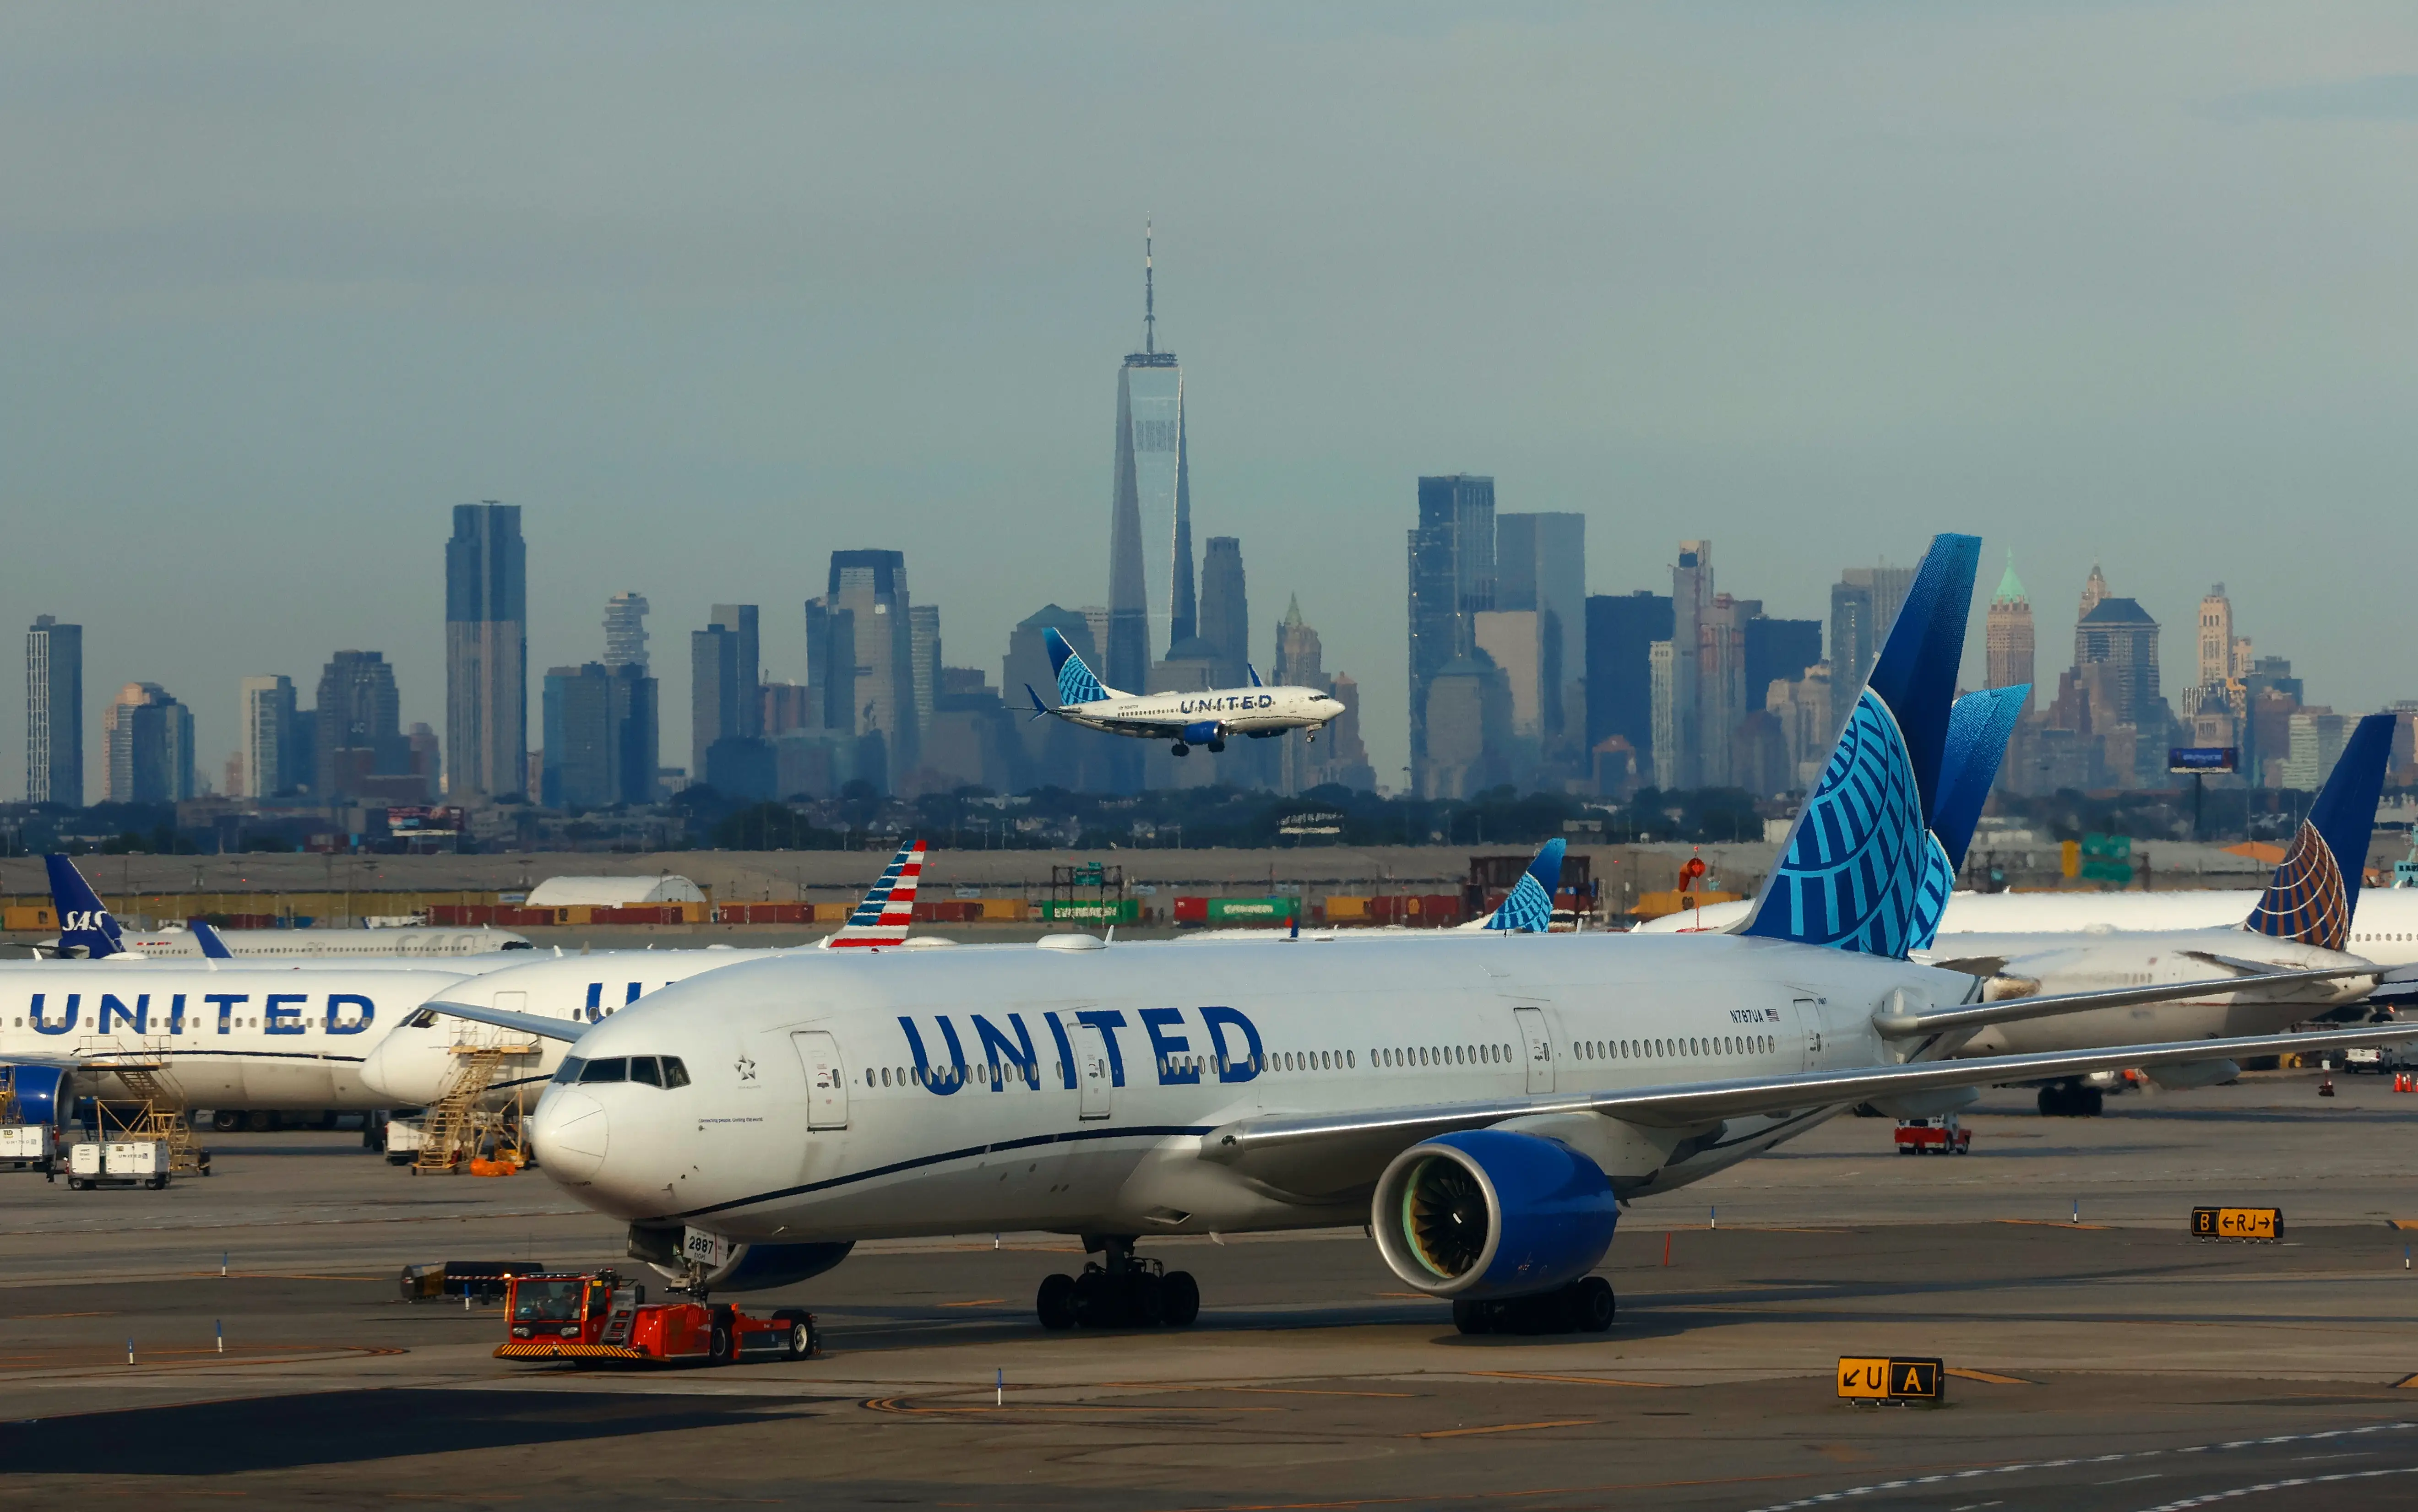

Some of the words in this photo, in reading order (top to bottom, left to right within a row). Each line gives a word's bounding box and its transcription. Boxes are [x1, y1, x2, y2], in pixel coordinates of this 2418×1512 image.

[1181, 694, 1272, 714] UNITED
[62, 910, 108, 931] SAS
[30, 994, 375, 1035] UNITED
[1729, 1009, 1764, 1024] N787UA
[898, 1006, 1263, 1096] UNITED
[2201, 1214, 2209, 1231] B
[2237, 1214, 2256, 1231] RJ
[688, 1235, 714, 1255] 2887
[1866, 1366, 1883, 1390] U
[1903, 1367, 1922, 1392] A
